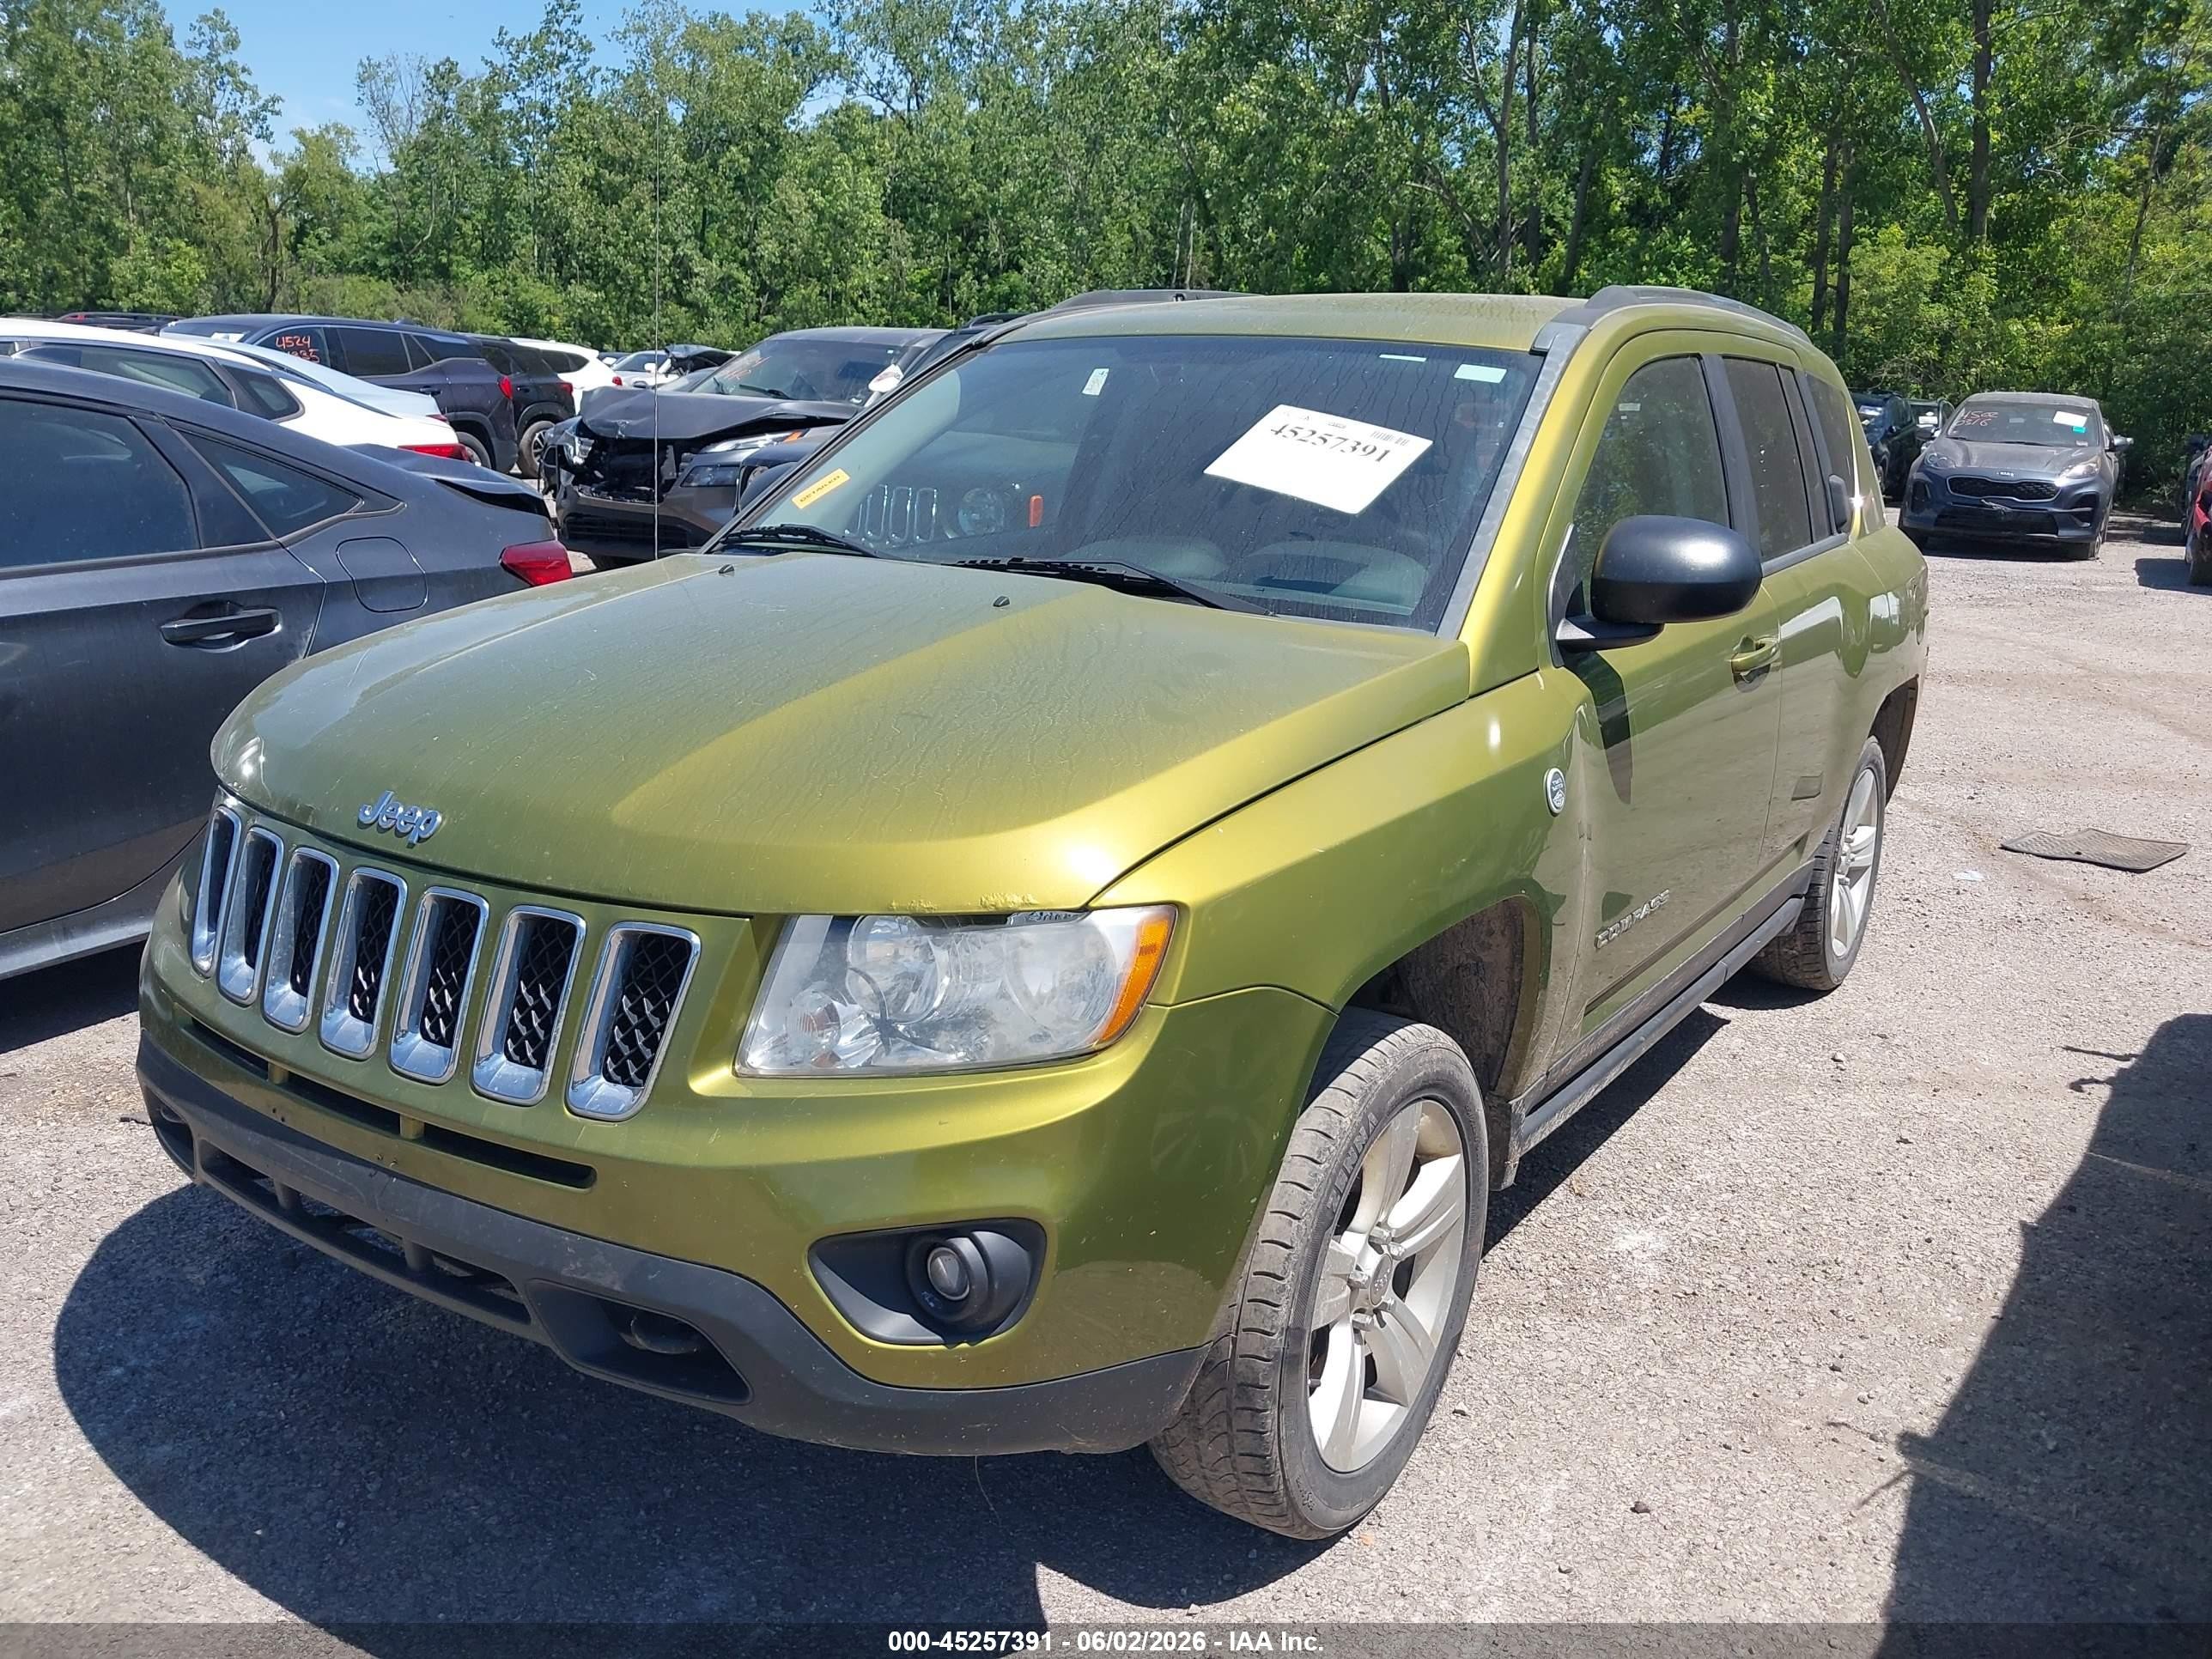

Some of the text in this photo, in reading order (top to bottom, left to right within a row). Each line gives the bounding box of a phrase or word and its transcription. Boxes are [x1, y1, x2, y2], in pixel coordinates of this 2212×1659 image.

[276, 335, 311, 349] 4524
[1270, 423, 1391, 462] 45257391
[358, 790, 442, 844] Jeep
